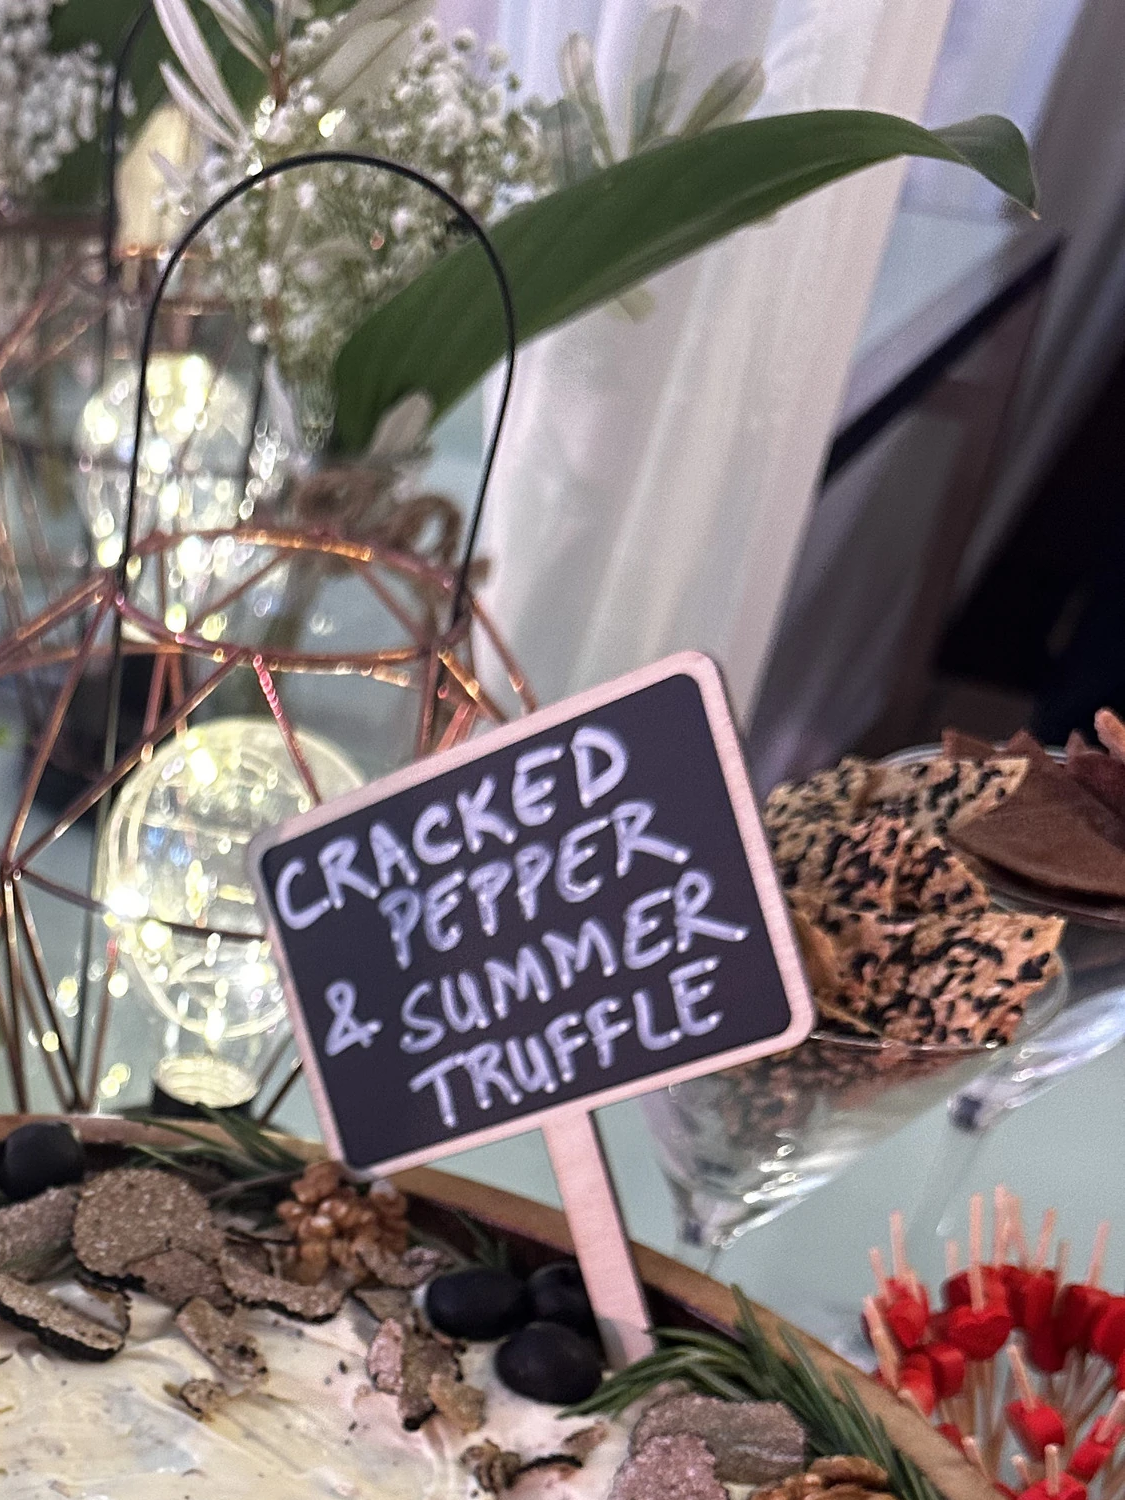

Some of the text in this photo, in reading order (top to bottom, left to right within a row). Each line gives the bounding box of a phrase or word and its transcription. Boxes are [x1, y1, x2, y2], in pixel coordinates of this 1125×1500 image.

[274, 725, 629, 930] CRACKED
[378, 800, 691, 970] PEPPER
[324, 869, 751, 1057] & SUMMER
[407, 956, 724, 1128] TRUFFLE
